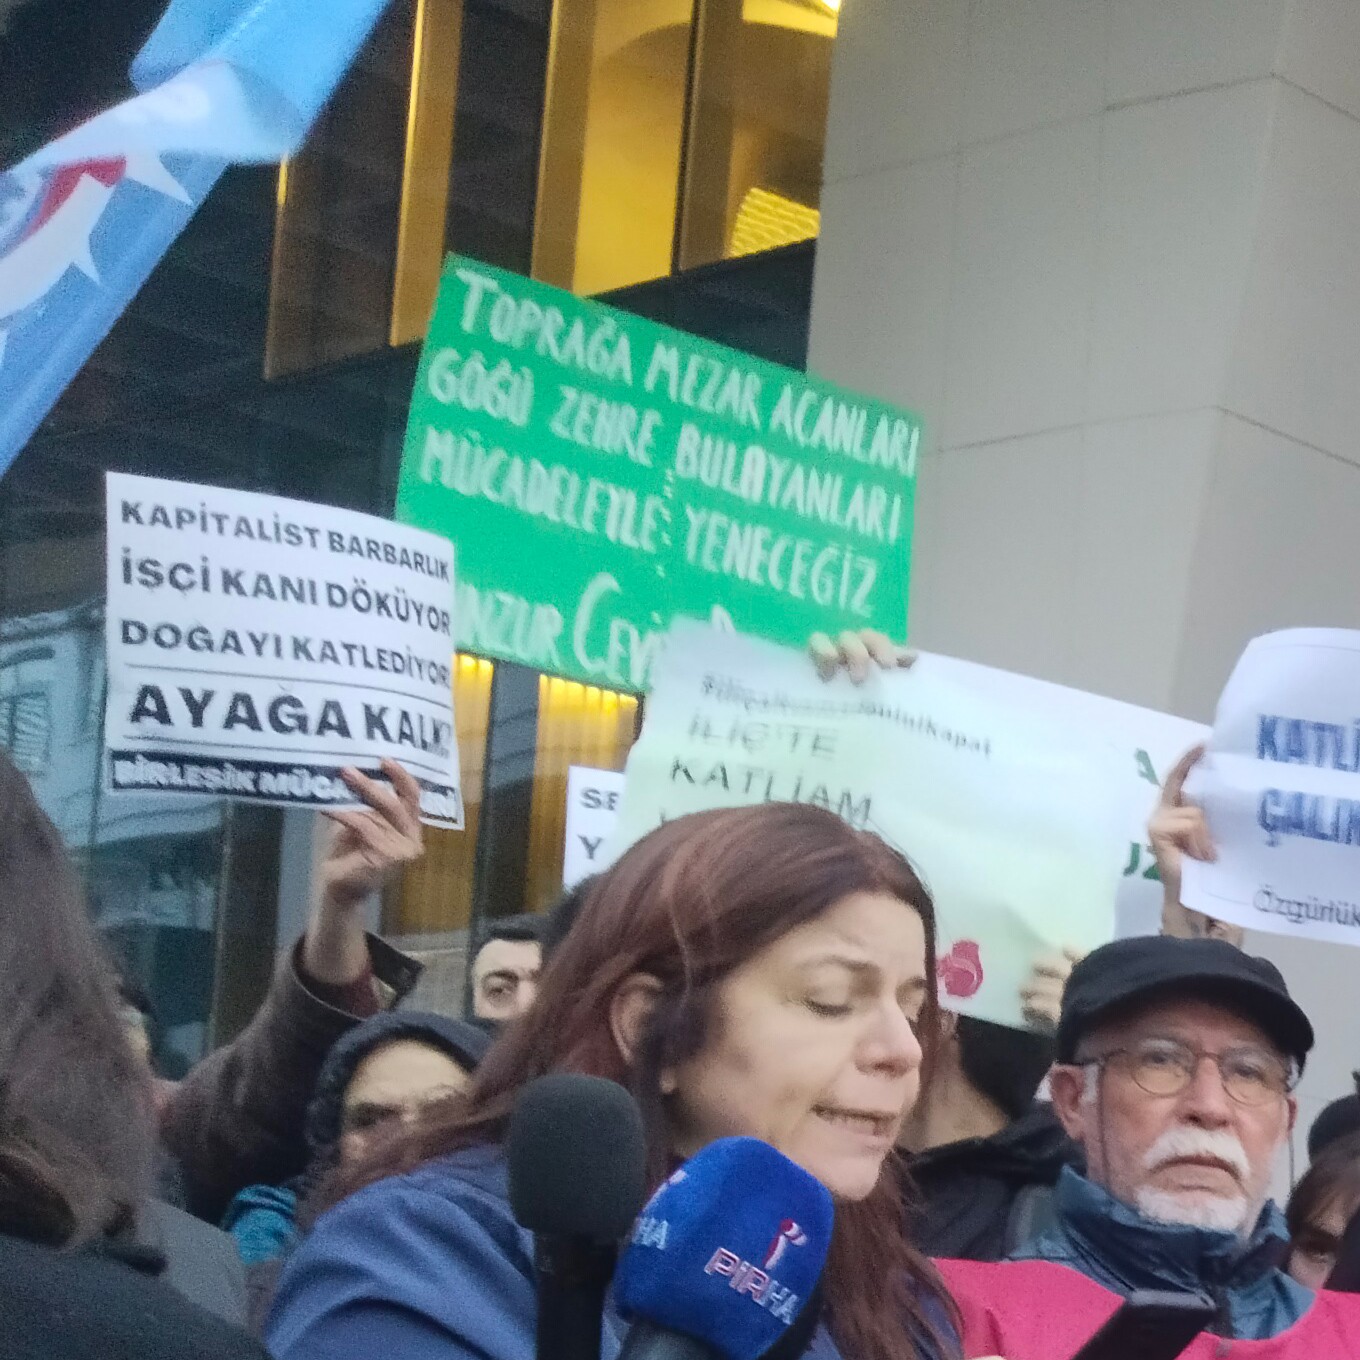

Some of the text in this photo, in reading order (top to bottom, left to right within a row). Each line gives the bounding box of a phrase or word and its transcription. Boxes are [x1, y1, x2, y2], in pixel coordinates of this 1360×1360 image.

[644, 341, 761, 430] MEZAR
[119, 499, 323, 549] KAPİTALİST
[219, 566, 318, 605] KANI
